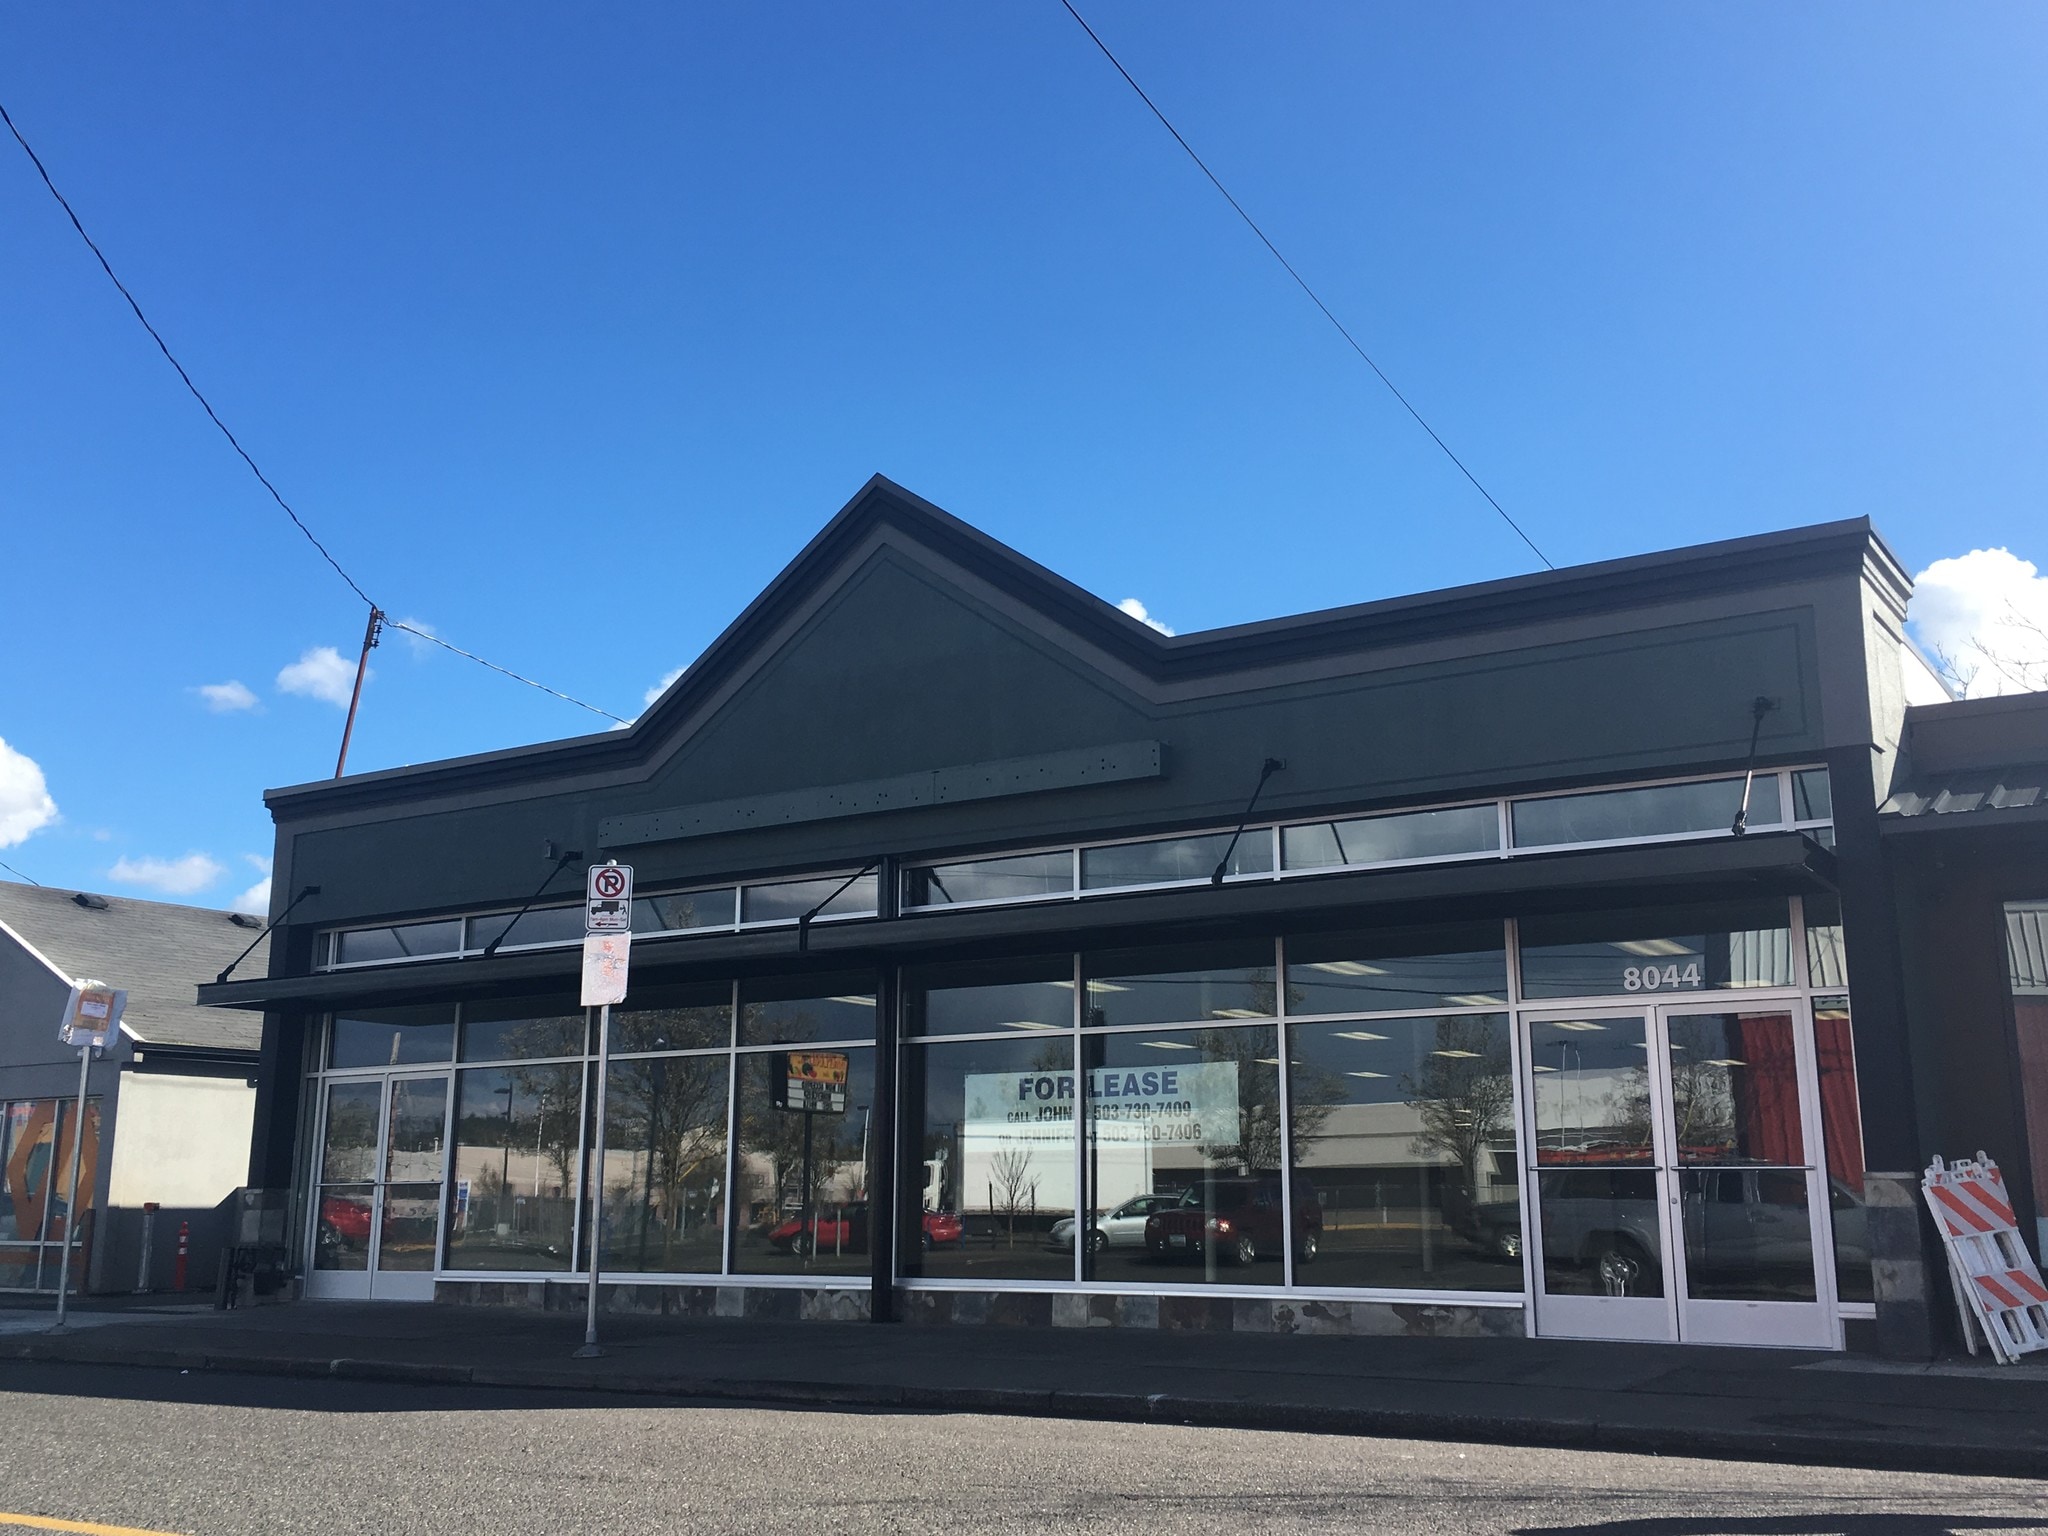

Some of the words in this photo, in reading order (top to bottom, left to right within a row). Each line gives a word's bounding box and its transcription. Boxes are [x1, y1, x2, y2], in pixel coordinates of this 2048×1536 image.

[1623, 963, 1701, 991] 8044
[1018, 1076, 1075, 1101] FOR
[1088, 1070, 1179, 1098] LEASE
[1007, 1111, 1031, 1123] CALL
[1035, 1105, 1073, 1122] JOHN
[1094, 1100, 1192, 1120] 503-730-7409
[1019, 1127, 1076, 1145] JENNIFE
